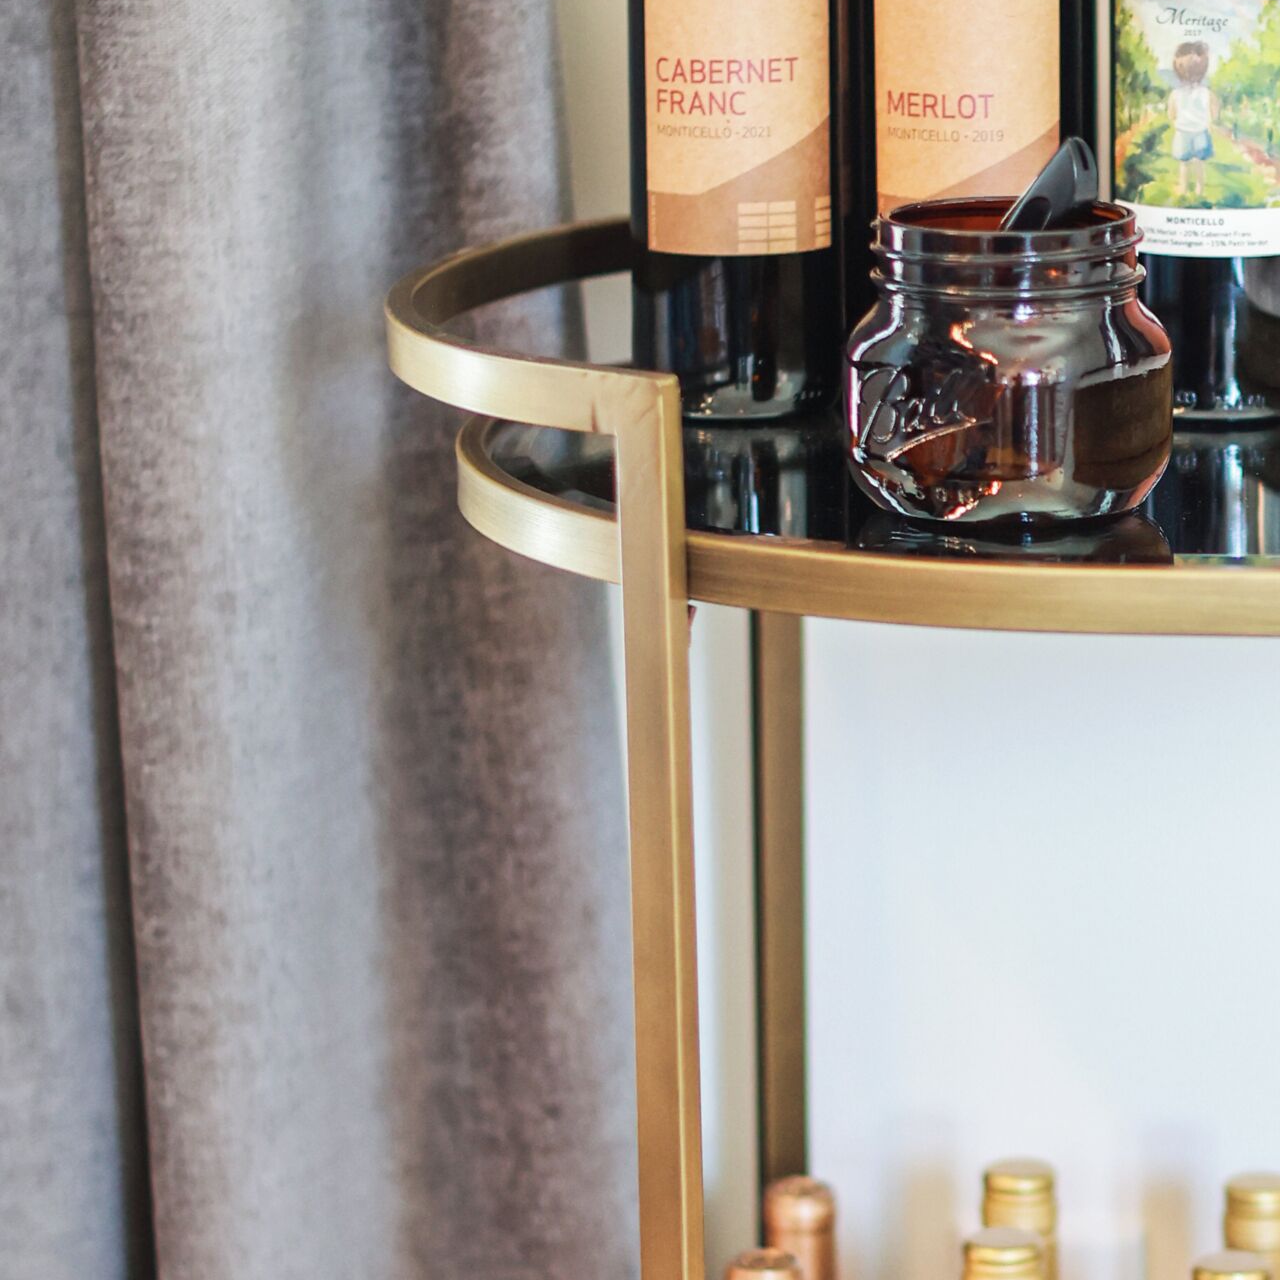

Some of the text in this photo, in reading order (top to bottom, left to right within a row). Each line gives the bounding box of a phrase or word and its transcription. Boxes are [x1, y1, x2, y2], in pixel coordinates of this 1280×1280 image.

[1155, 7, 1229, 33] Meritage
[655, 56, 799, 84] CABERNET
[656, 88, 746, 116] FRANC
[886, 89, 995, 119] MERLOT
[657, 124, 732, 139] MONTICELLO
[742, 125, 772, 138] 2021
[887, 126, 960, 143] MONTICELLO
[972, 129, 1005, 143] 2019
[1165, 216, 1225, 226] MONTICELLO
